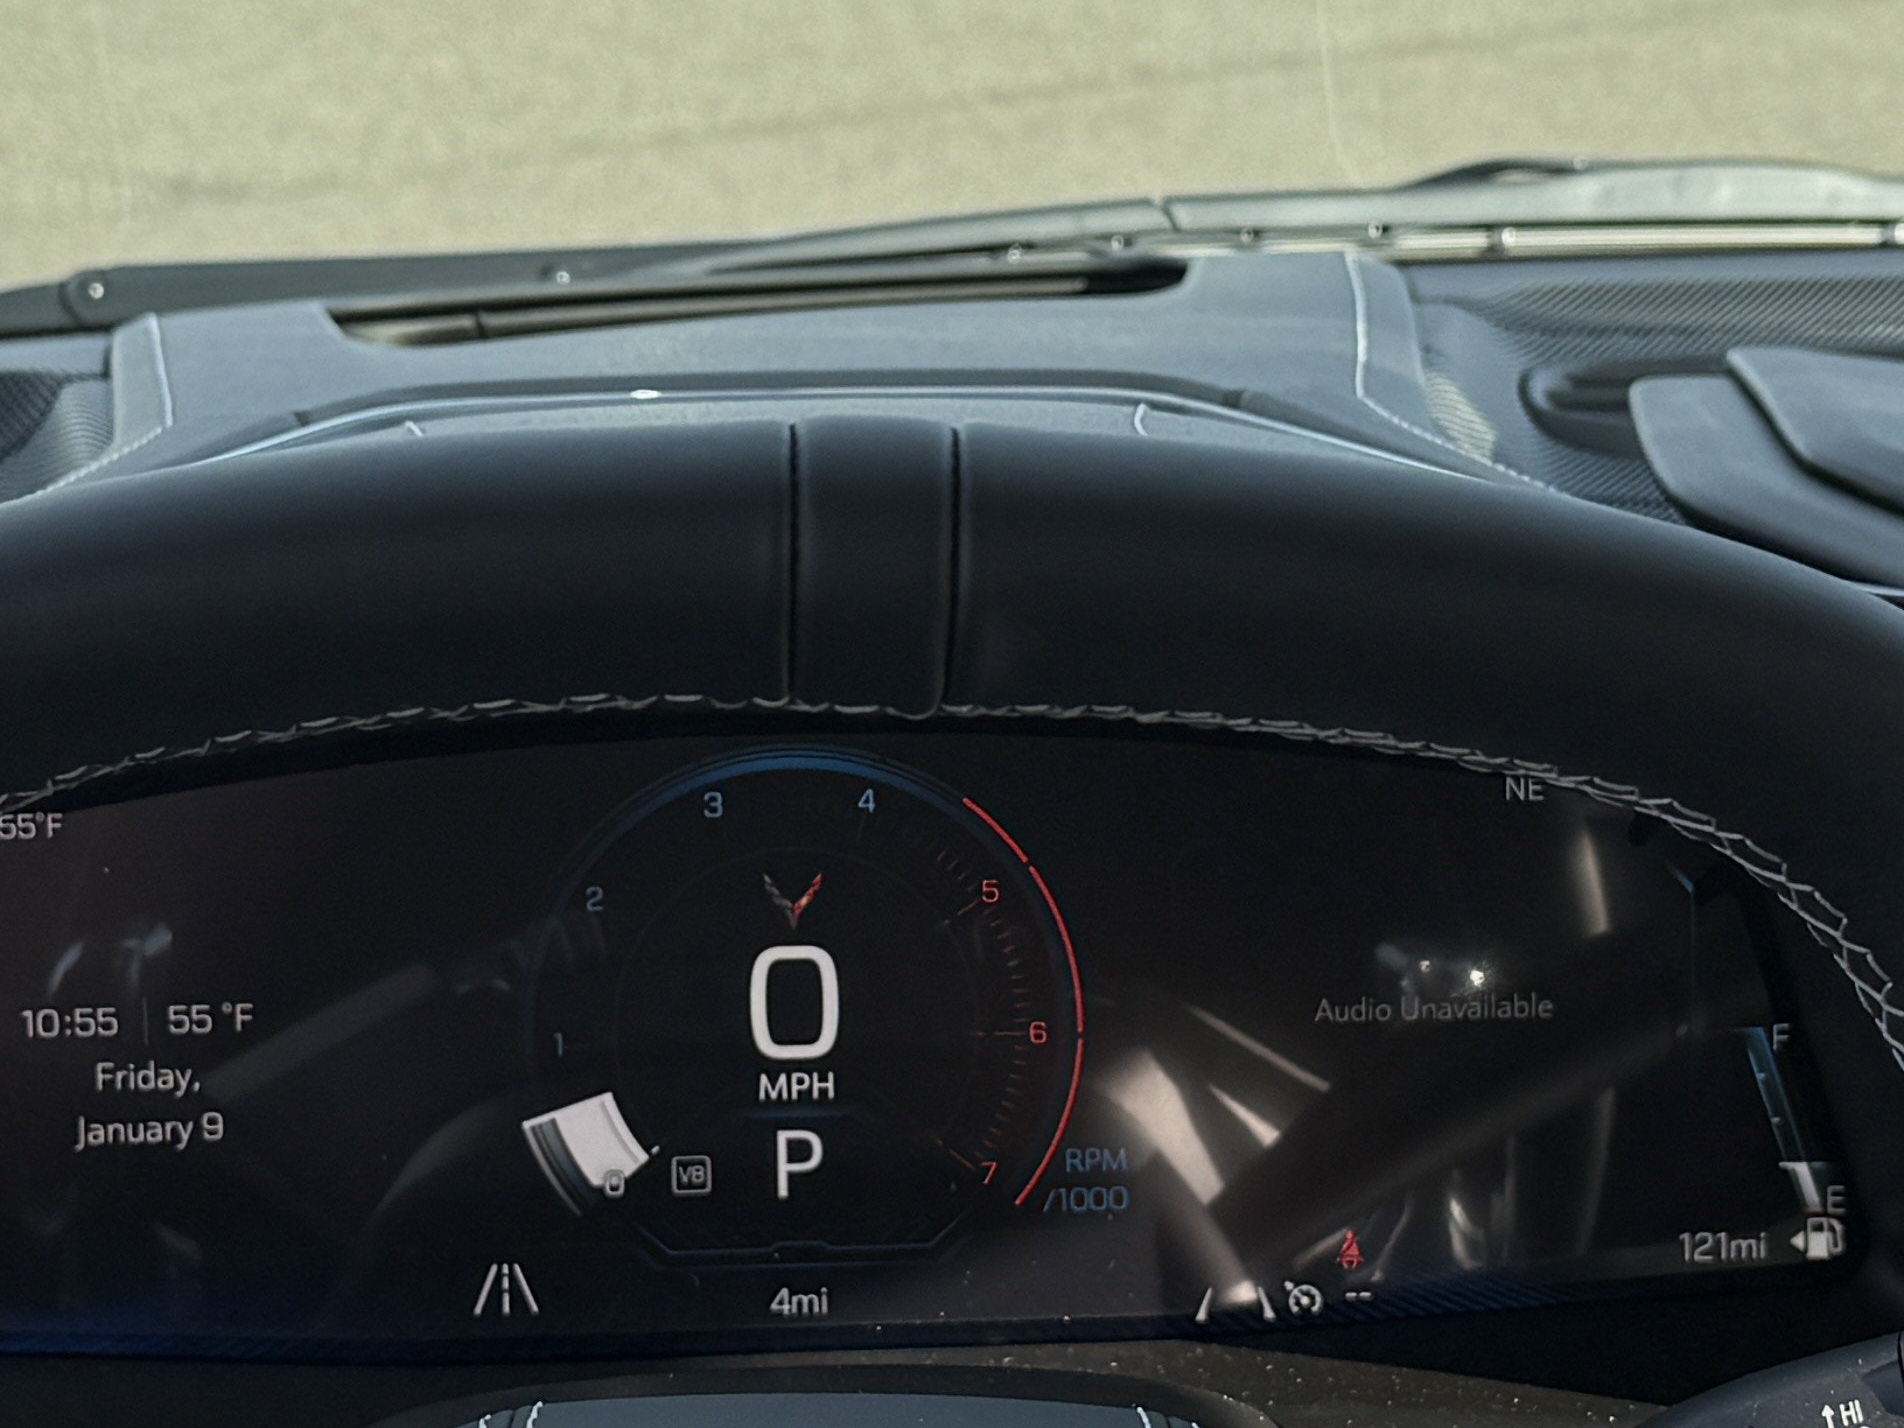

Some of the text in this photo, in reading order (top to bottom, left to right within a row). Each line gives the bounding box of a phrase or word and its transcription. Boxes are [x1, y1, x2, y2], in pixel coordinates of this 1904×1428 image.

[858, 789, 875, 814] 4
[1504, 777, 1544, 801] NE
[703, 792, 723, 818] 3
[586, 886, 604, 913] 2
[981, 879, 999, 905] 5
[750, 945, 839, 1060] 0
[1315, 992, 1554, 1023] Audio Unavailable
[21, 1008, 118, 1038] 10:55
[168, 1006, 213, 1035] 55
[1029, 1021, 1047, 1045] 6
[553, 1032, 564, 1057] 1
[1773, 1023, 1790, 1049] F
[96, 1061, 201, 1098] Friday,
[758, 1073, 835, 1101] MPH
[75, 1112, 224, 1152] January 9
[776, 1129, 824, 1199] P
[1065, 1148, 1127, 1172] RPM
[678, 1163, 706, 1187] V8
[1043, 1186, 1129, 1213] /1000
[1827, 1186, 1845, 1213] E
[1678, 1231, 1768, 1261] 121mi
[770, 1287, 829, 1316] 4mi
[1839, 1400, 1864, 1426] HI
